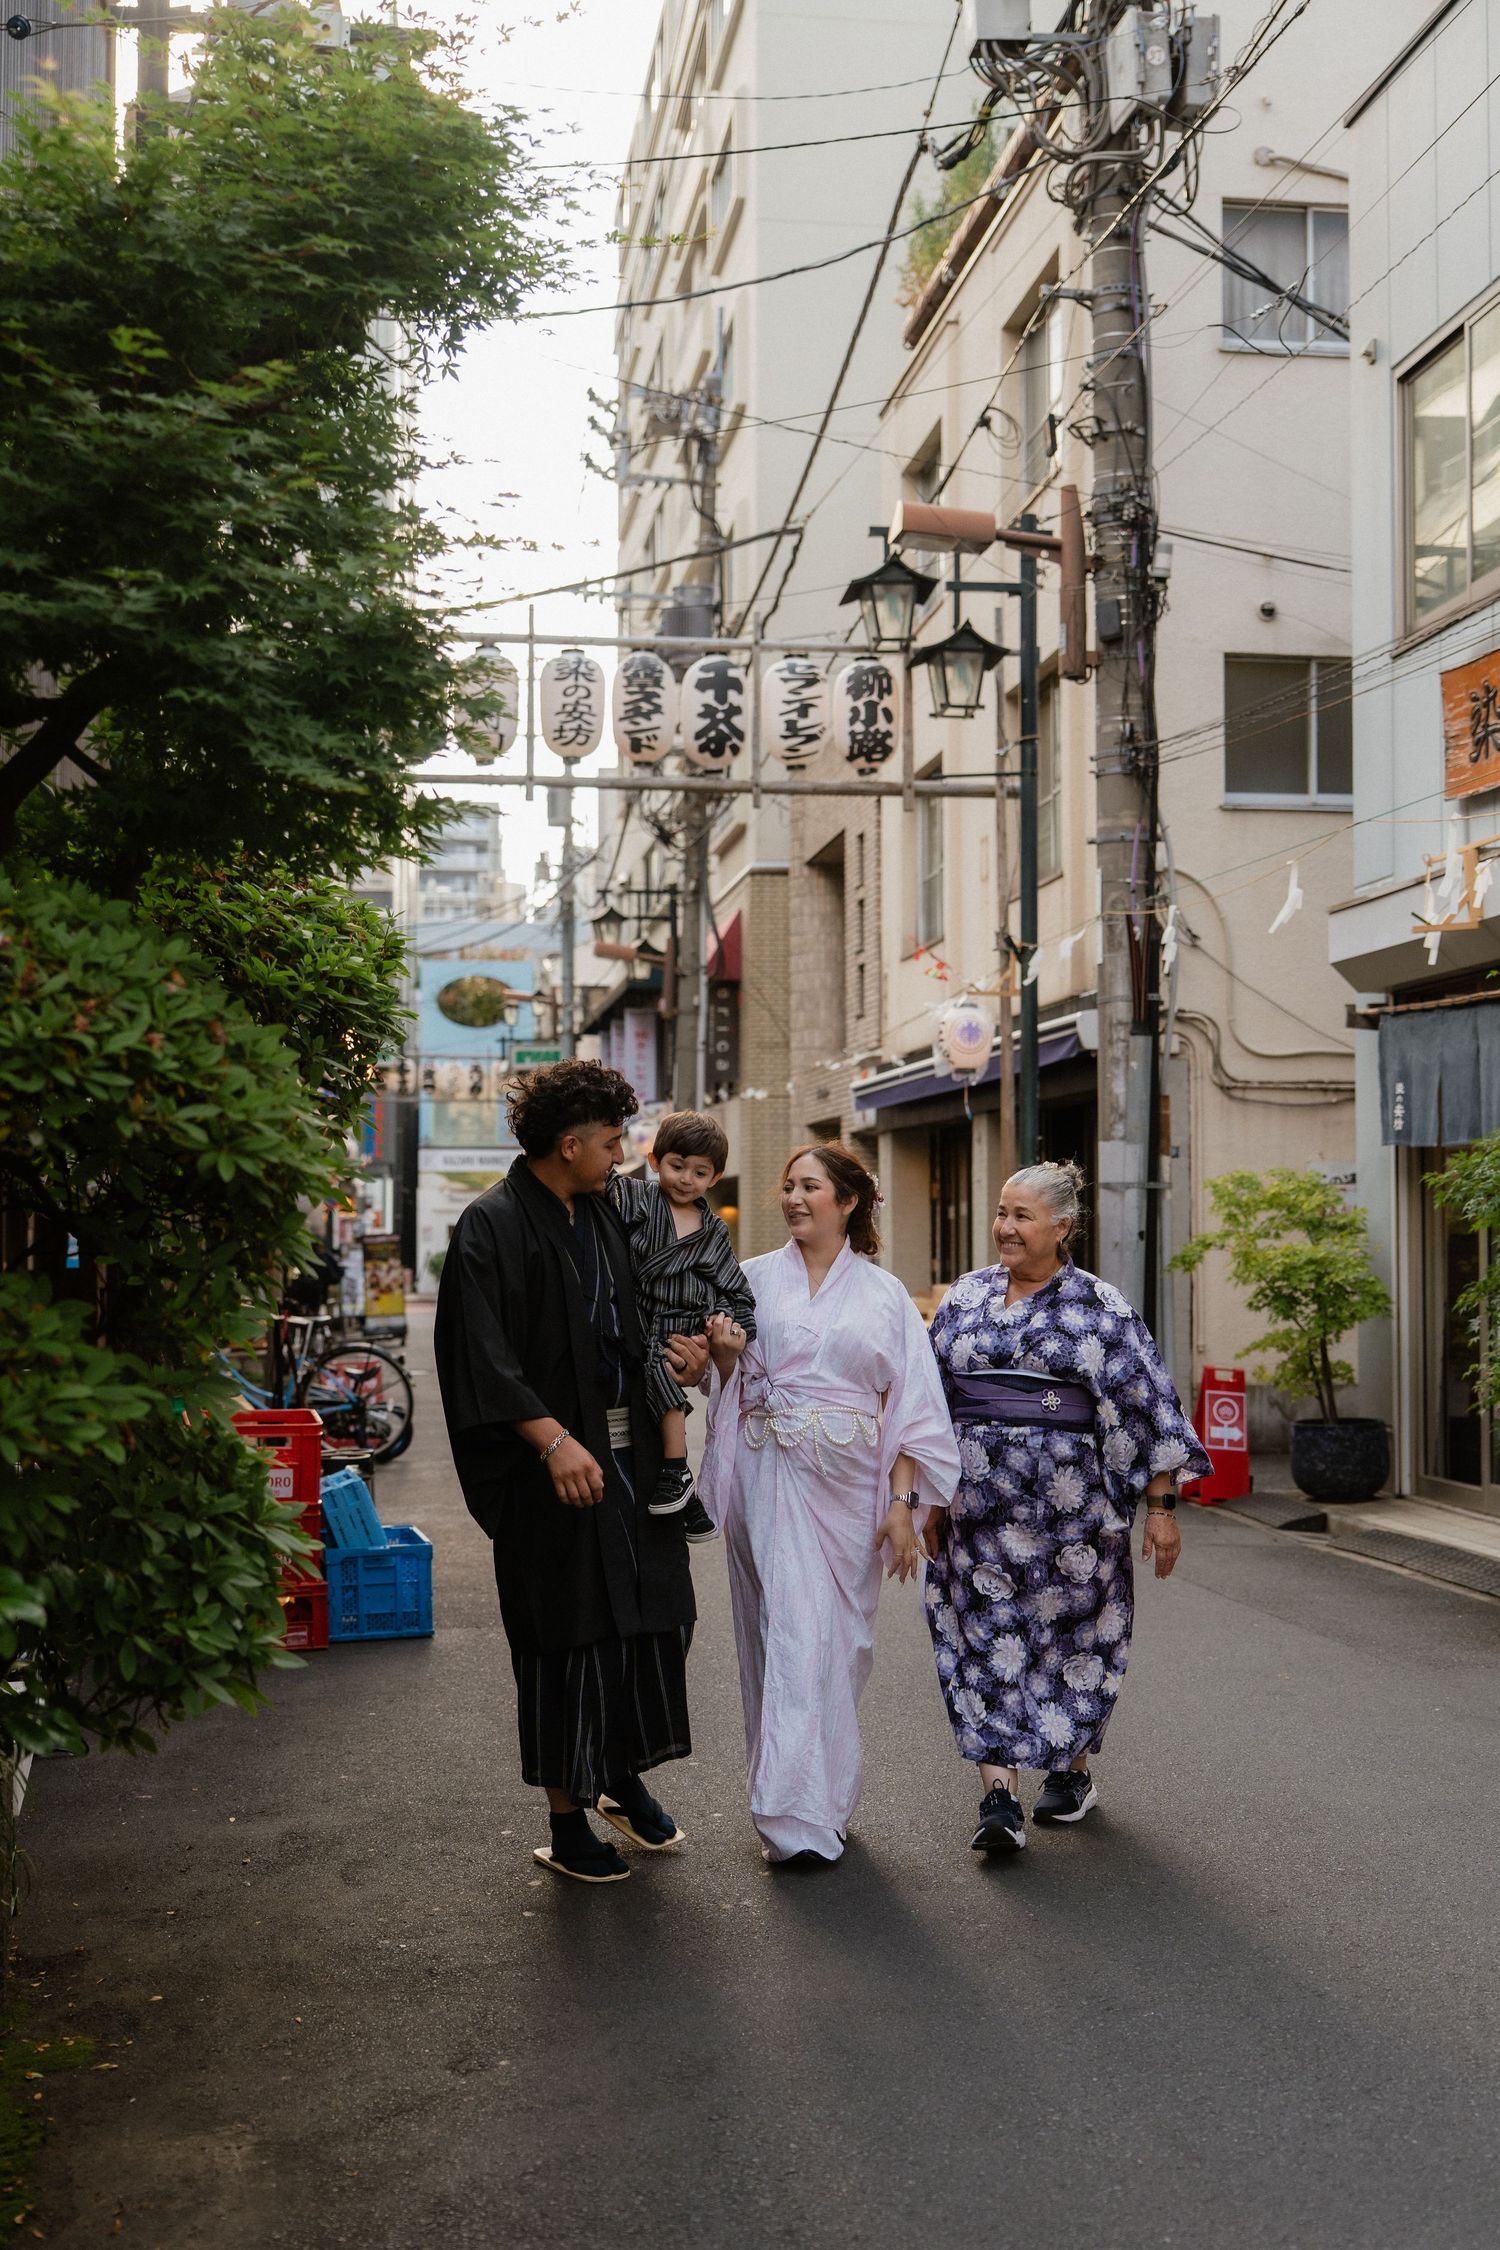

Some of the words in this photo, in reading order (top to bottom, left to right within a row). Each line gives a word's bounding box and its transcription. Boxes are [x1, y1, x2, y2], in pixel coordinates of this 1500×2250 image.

[552, 657, 598, 747] 染の安坊
[845, 665, 893, 763] 柳小路
